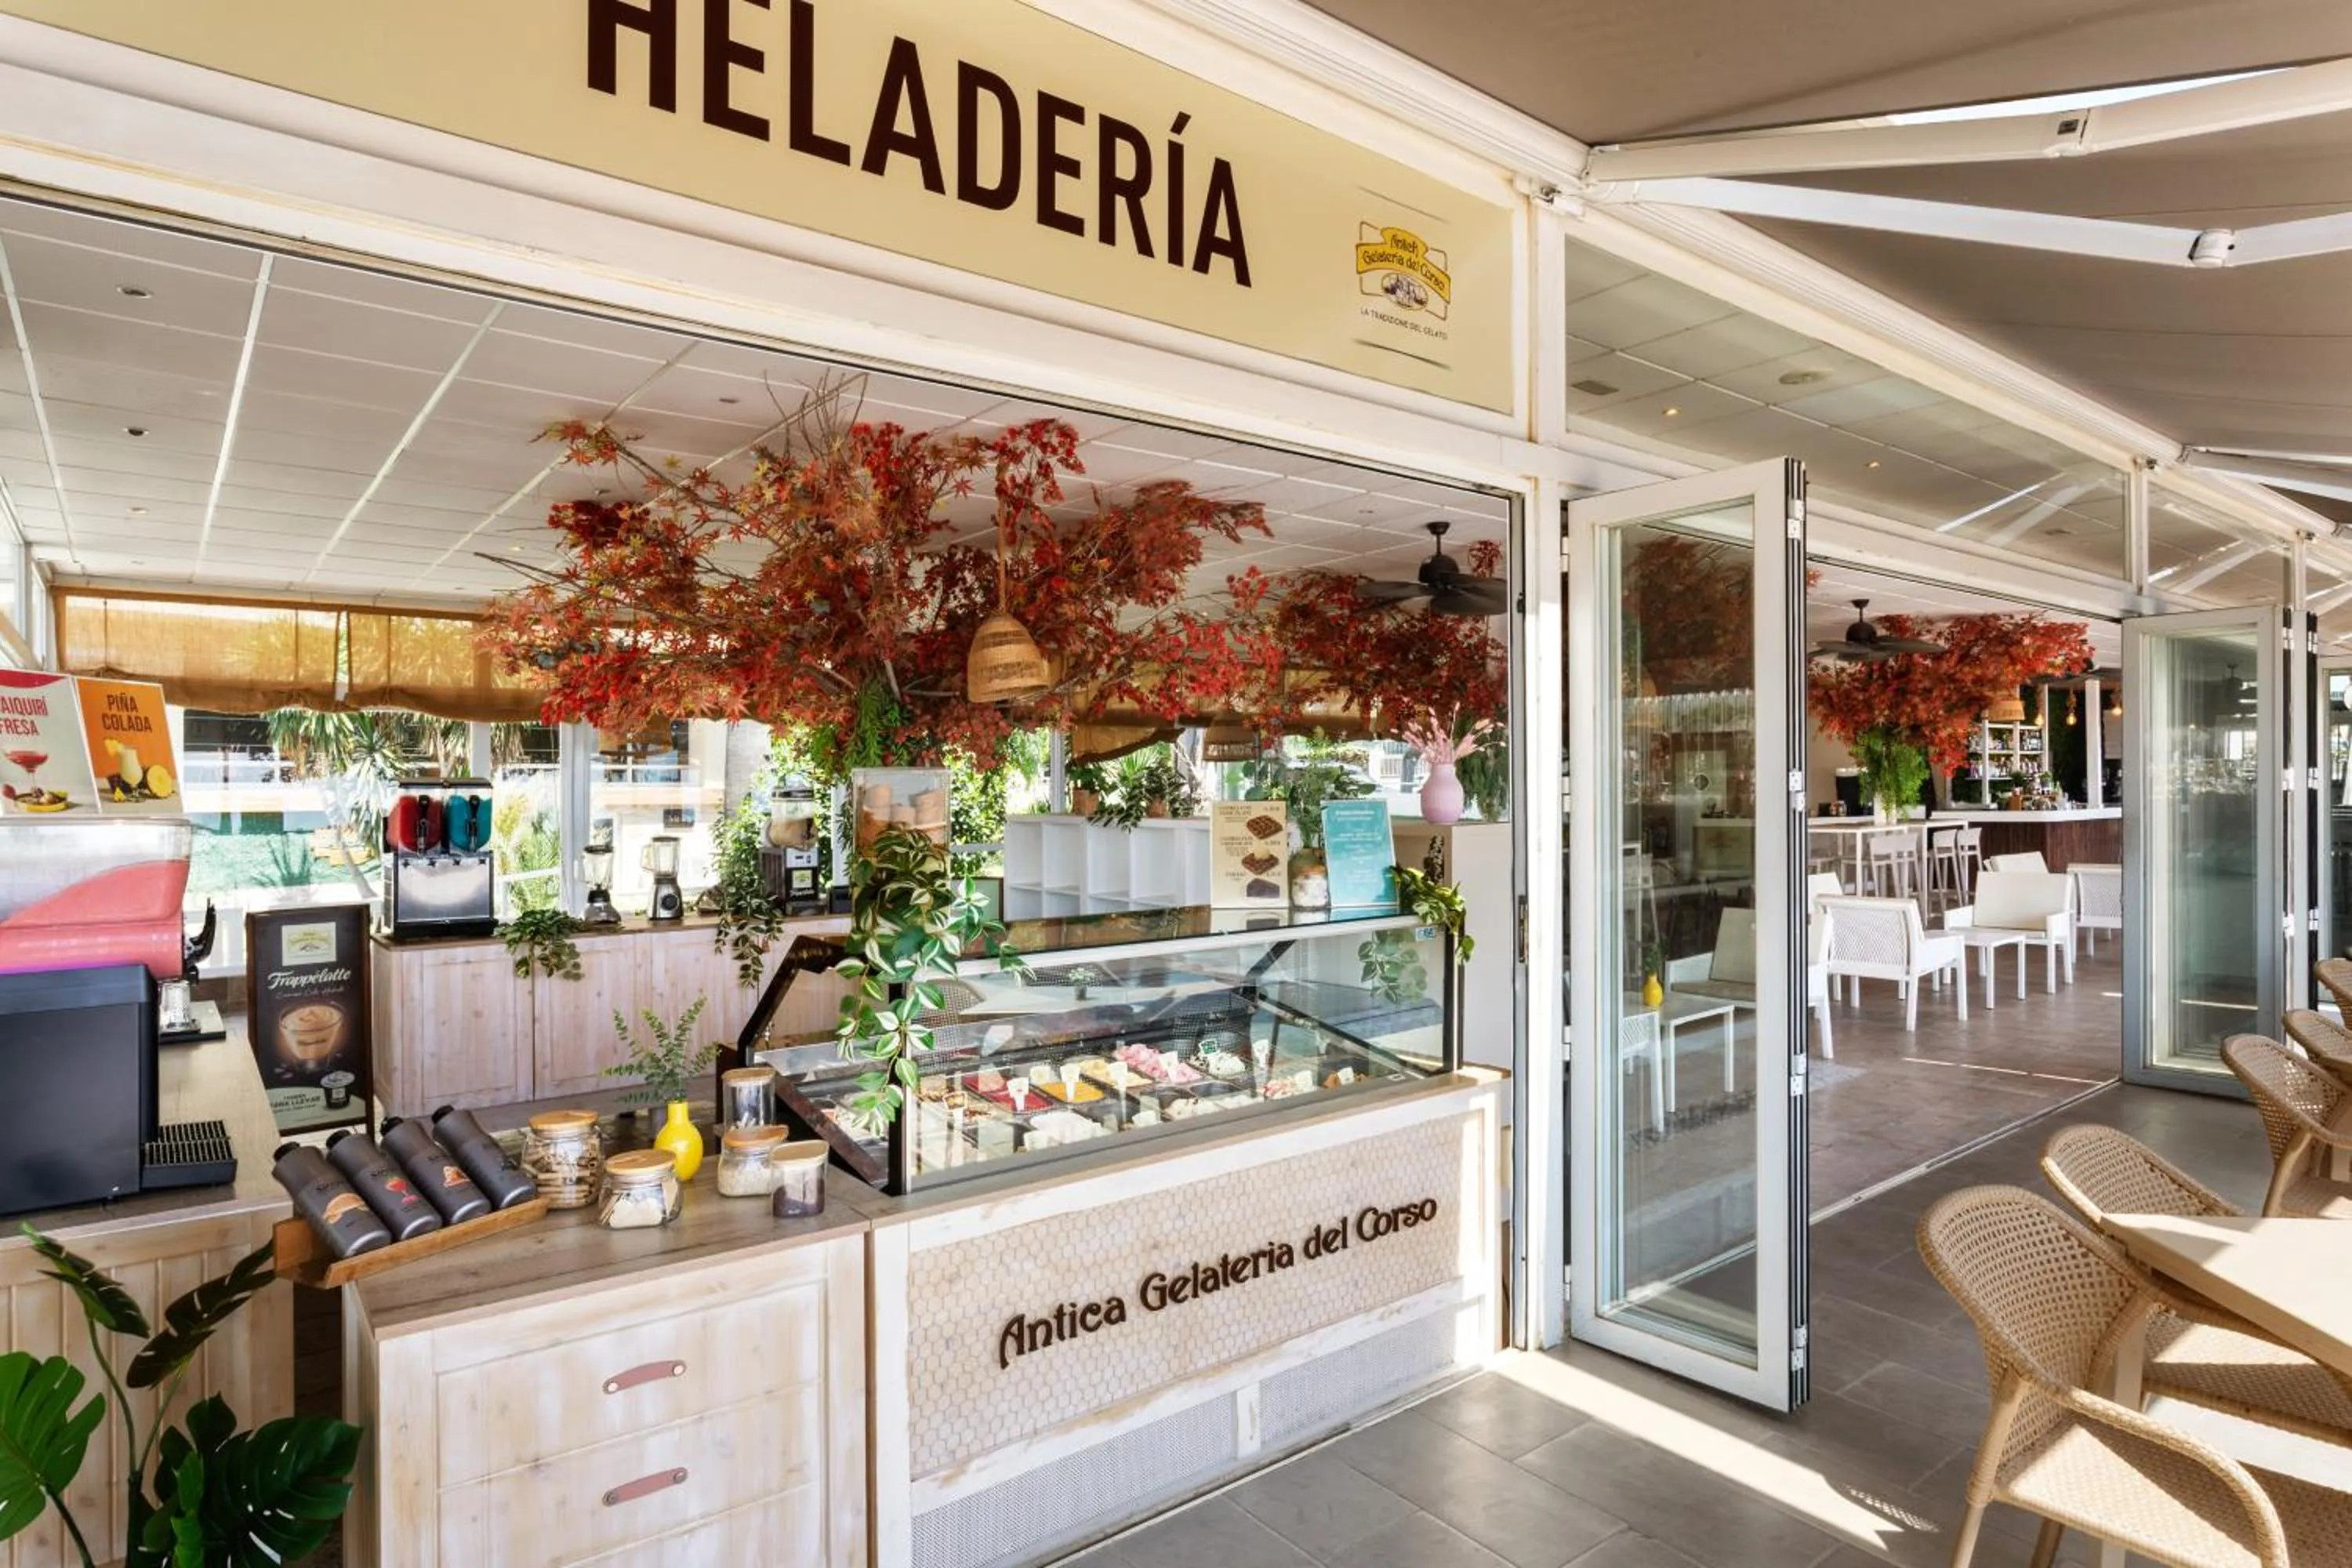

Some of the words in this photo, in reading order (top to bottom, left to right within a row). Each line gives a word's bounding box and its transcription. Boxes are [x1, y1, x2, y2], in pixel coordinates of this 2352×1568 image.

[587, 0, 1252, 289] HELADERÍA
[0, 695, 49, 716] AIQUIRÍ
[107, 692, 138, 713] PIÑA
[102, 713, 152, 732] COLADA
[1000, 1296, 1127, 1370] Antica
[1139, 1243, 1294, 1312] Gelateria
[1302, 1216, 1348, 1260] del
[1356, 1197, 1438, 1243] Corso
